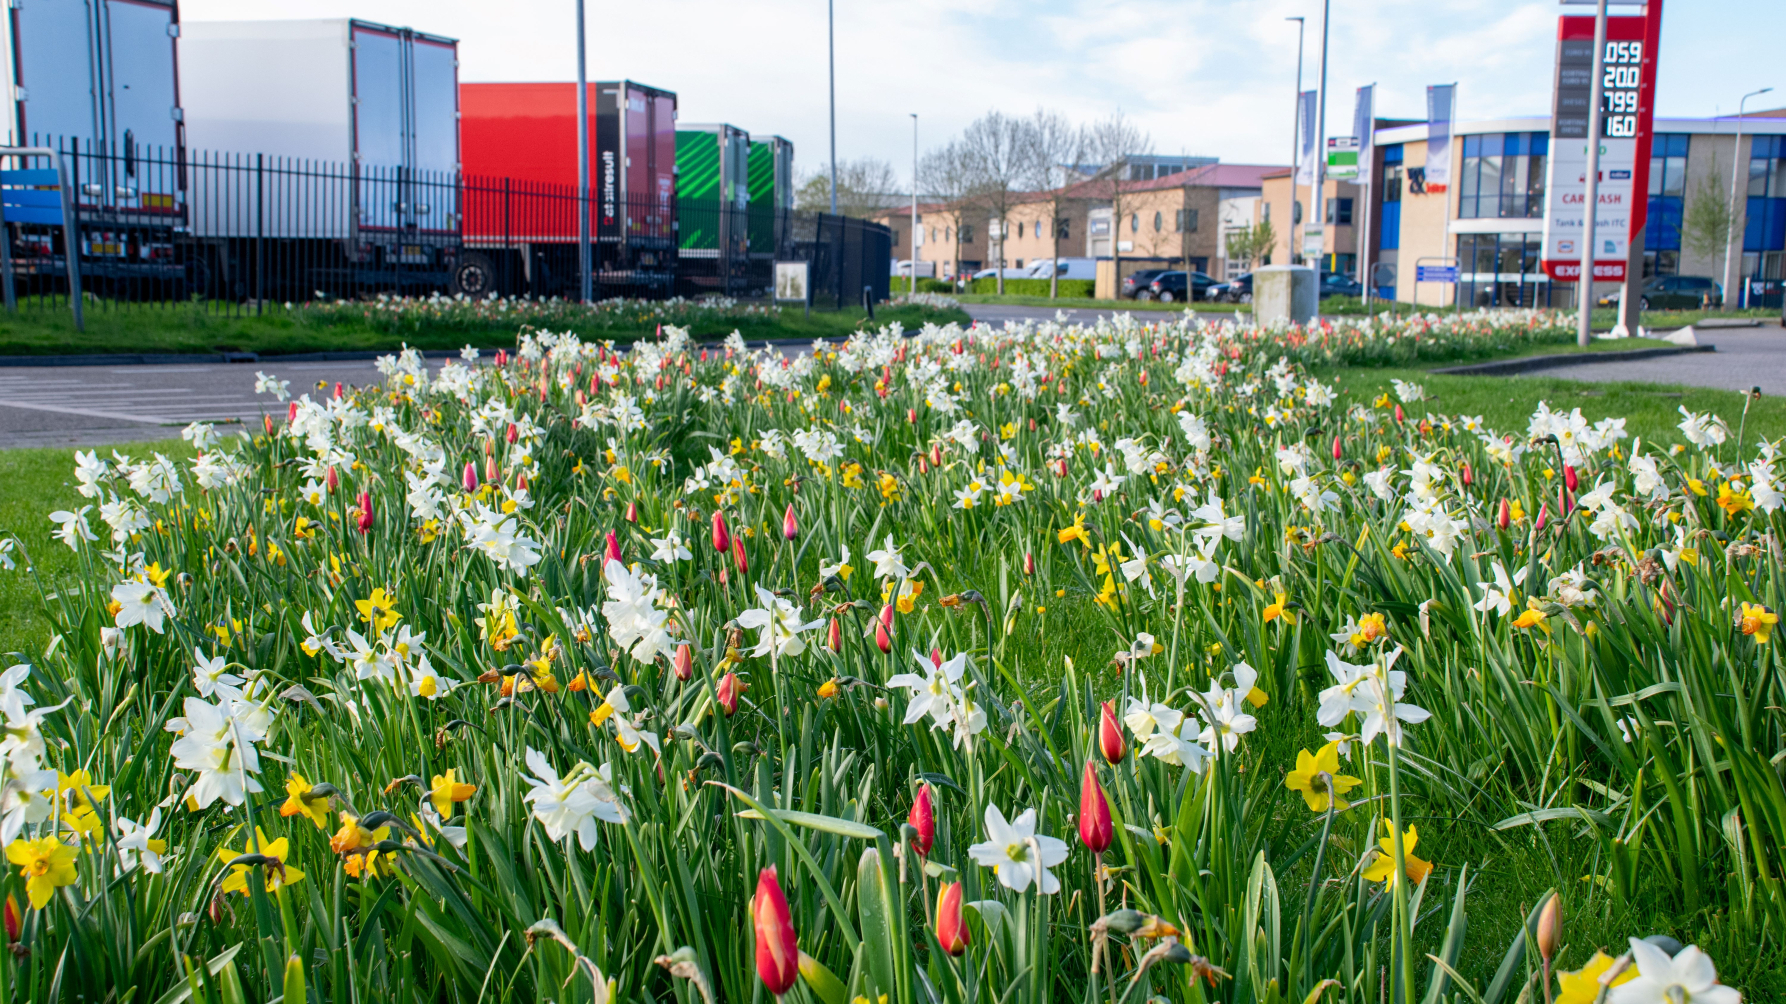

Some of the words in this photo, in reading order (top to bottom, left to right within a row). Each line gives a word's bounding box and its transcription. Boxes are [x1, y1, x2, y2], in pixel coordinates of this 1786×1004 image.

[1562, 193, 1622, 204] CARASH
[1555, 219, 1575, 227] Tank
[1554, 265, 1624, 277] EXPESS
